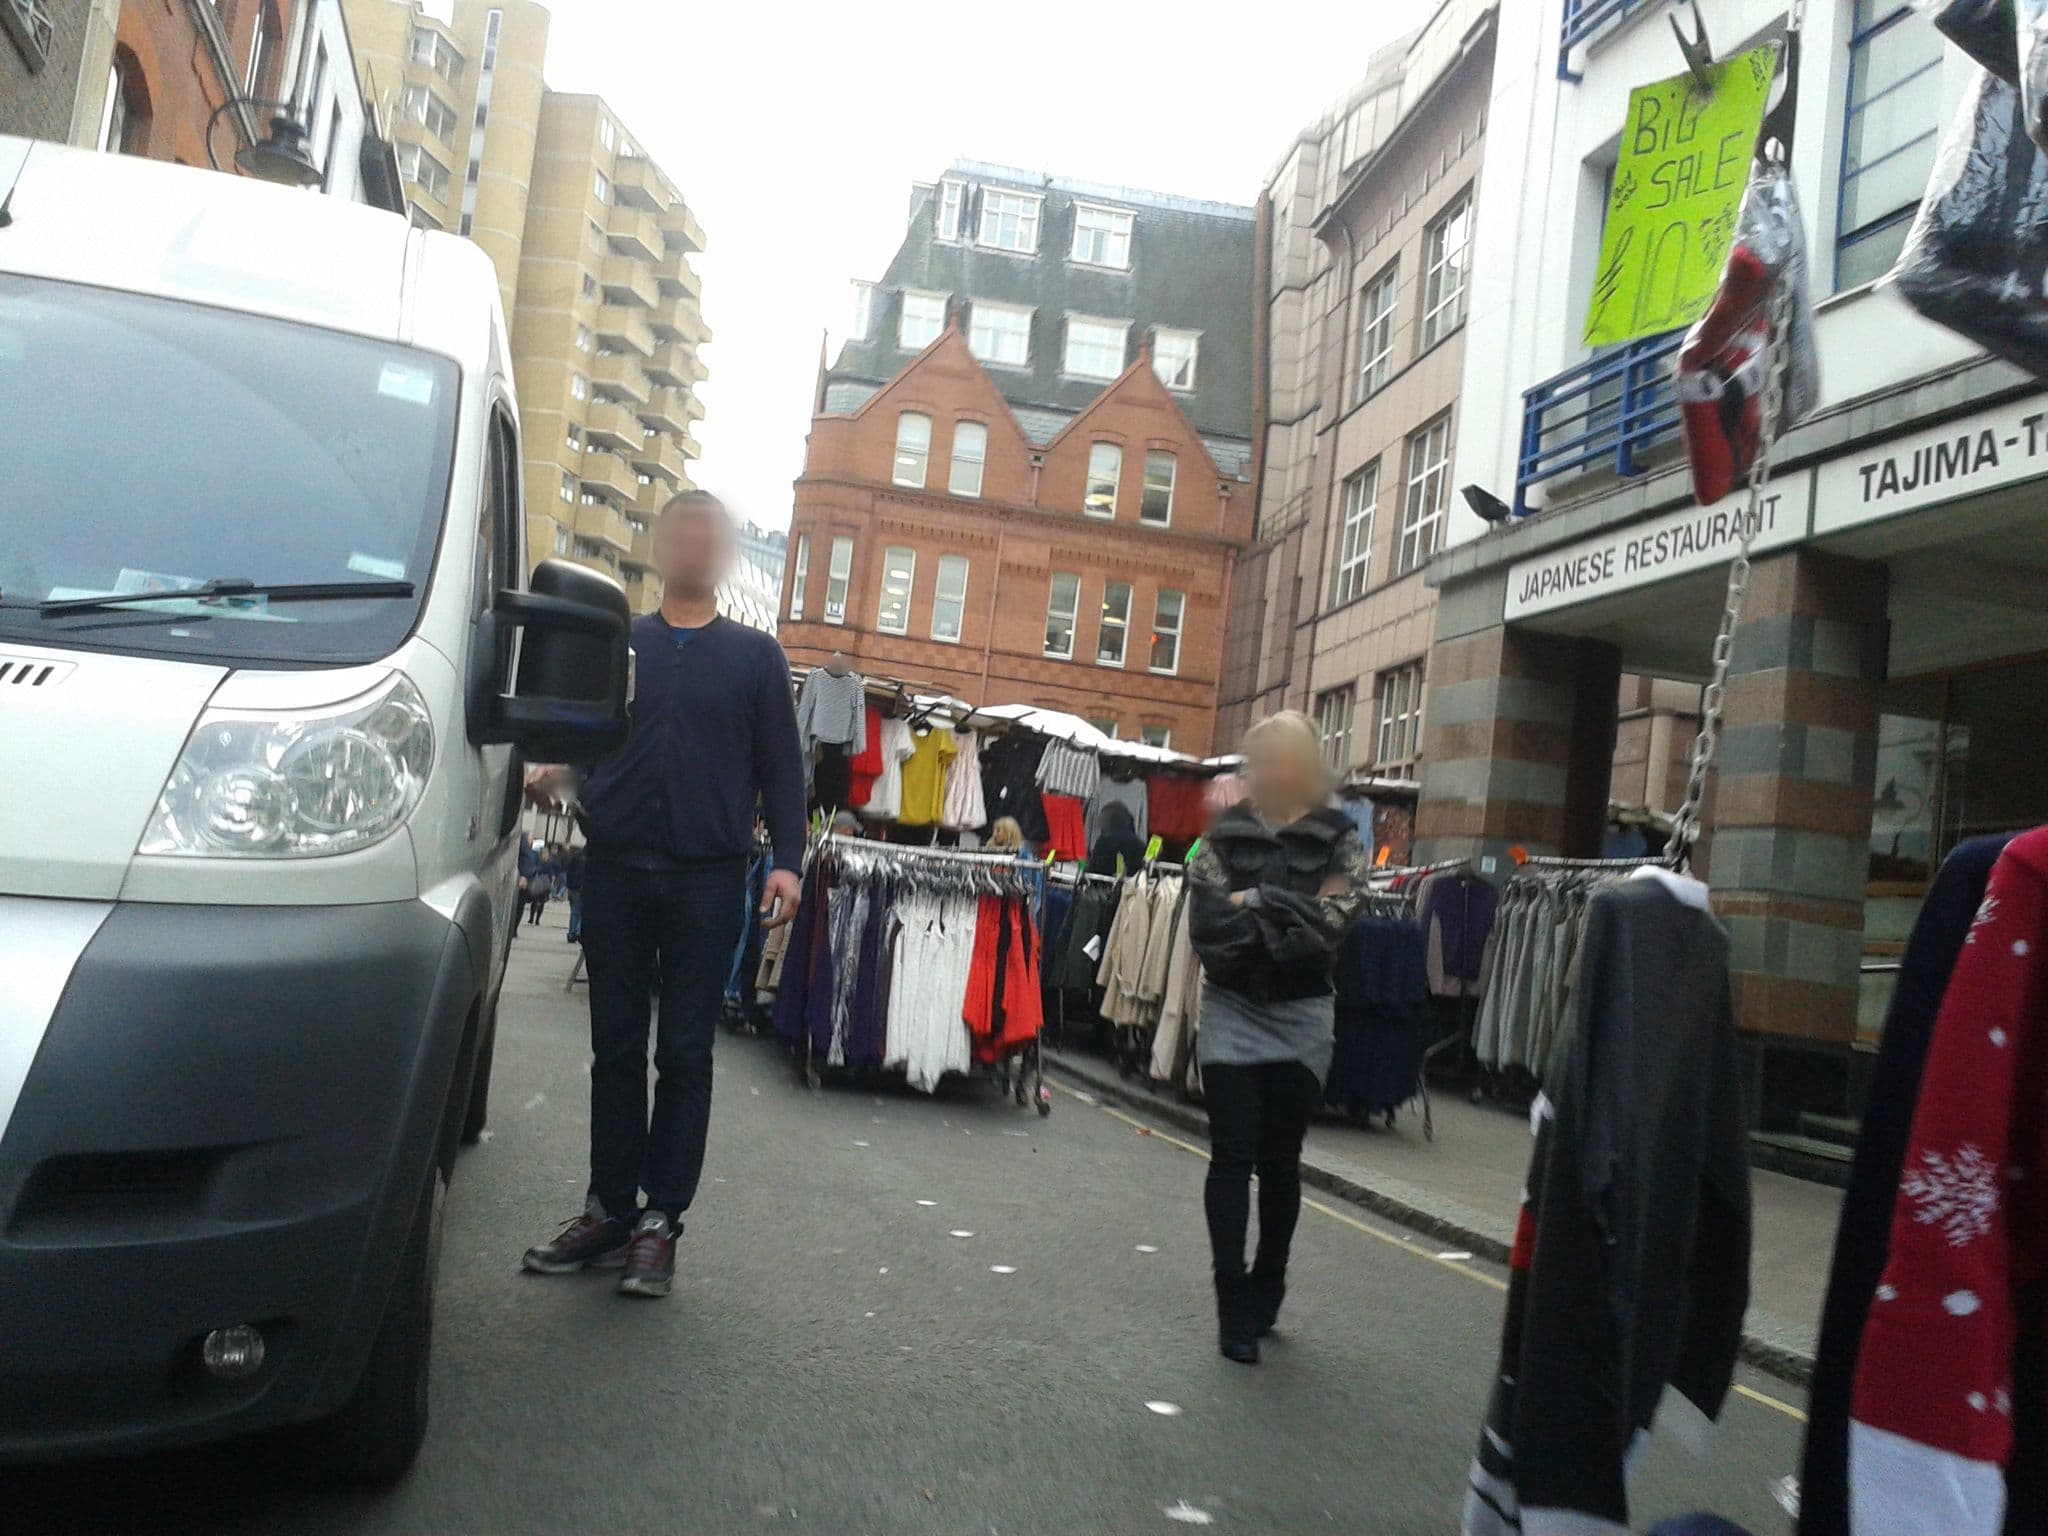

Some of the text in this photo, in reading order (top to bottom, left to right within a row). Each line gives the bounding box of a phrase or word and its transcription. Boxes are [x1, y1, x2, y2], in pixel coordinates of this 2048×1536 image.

[1645, 130, 1743, 210] SALE
[1859, 413, 2048, 502] TAJIMA-T
[1518, 494, 1781, 605] JAPANESE RESTAURANT
